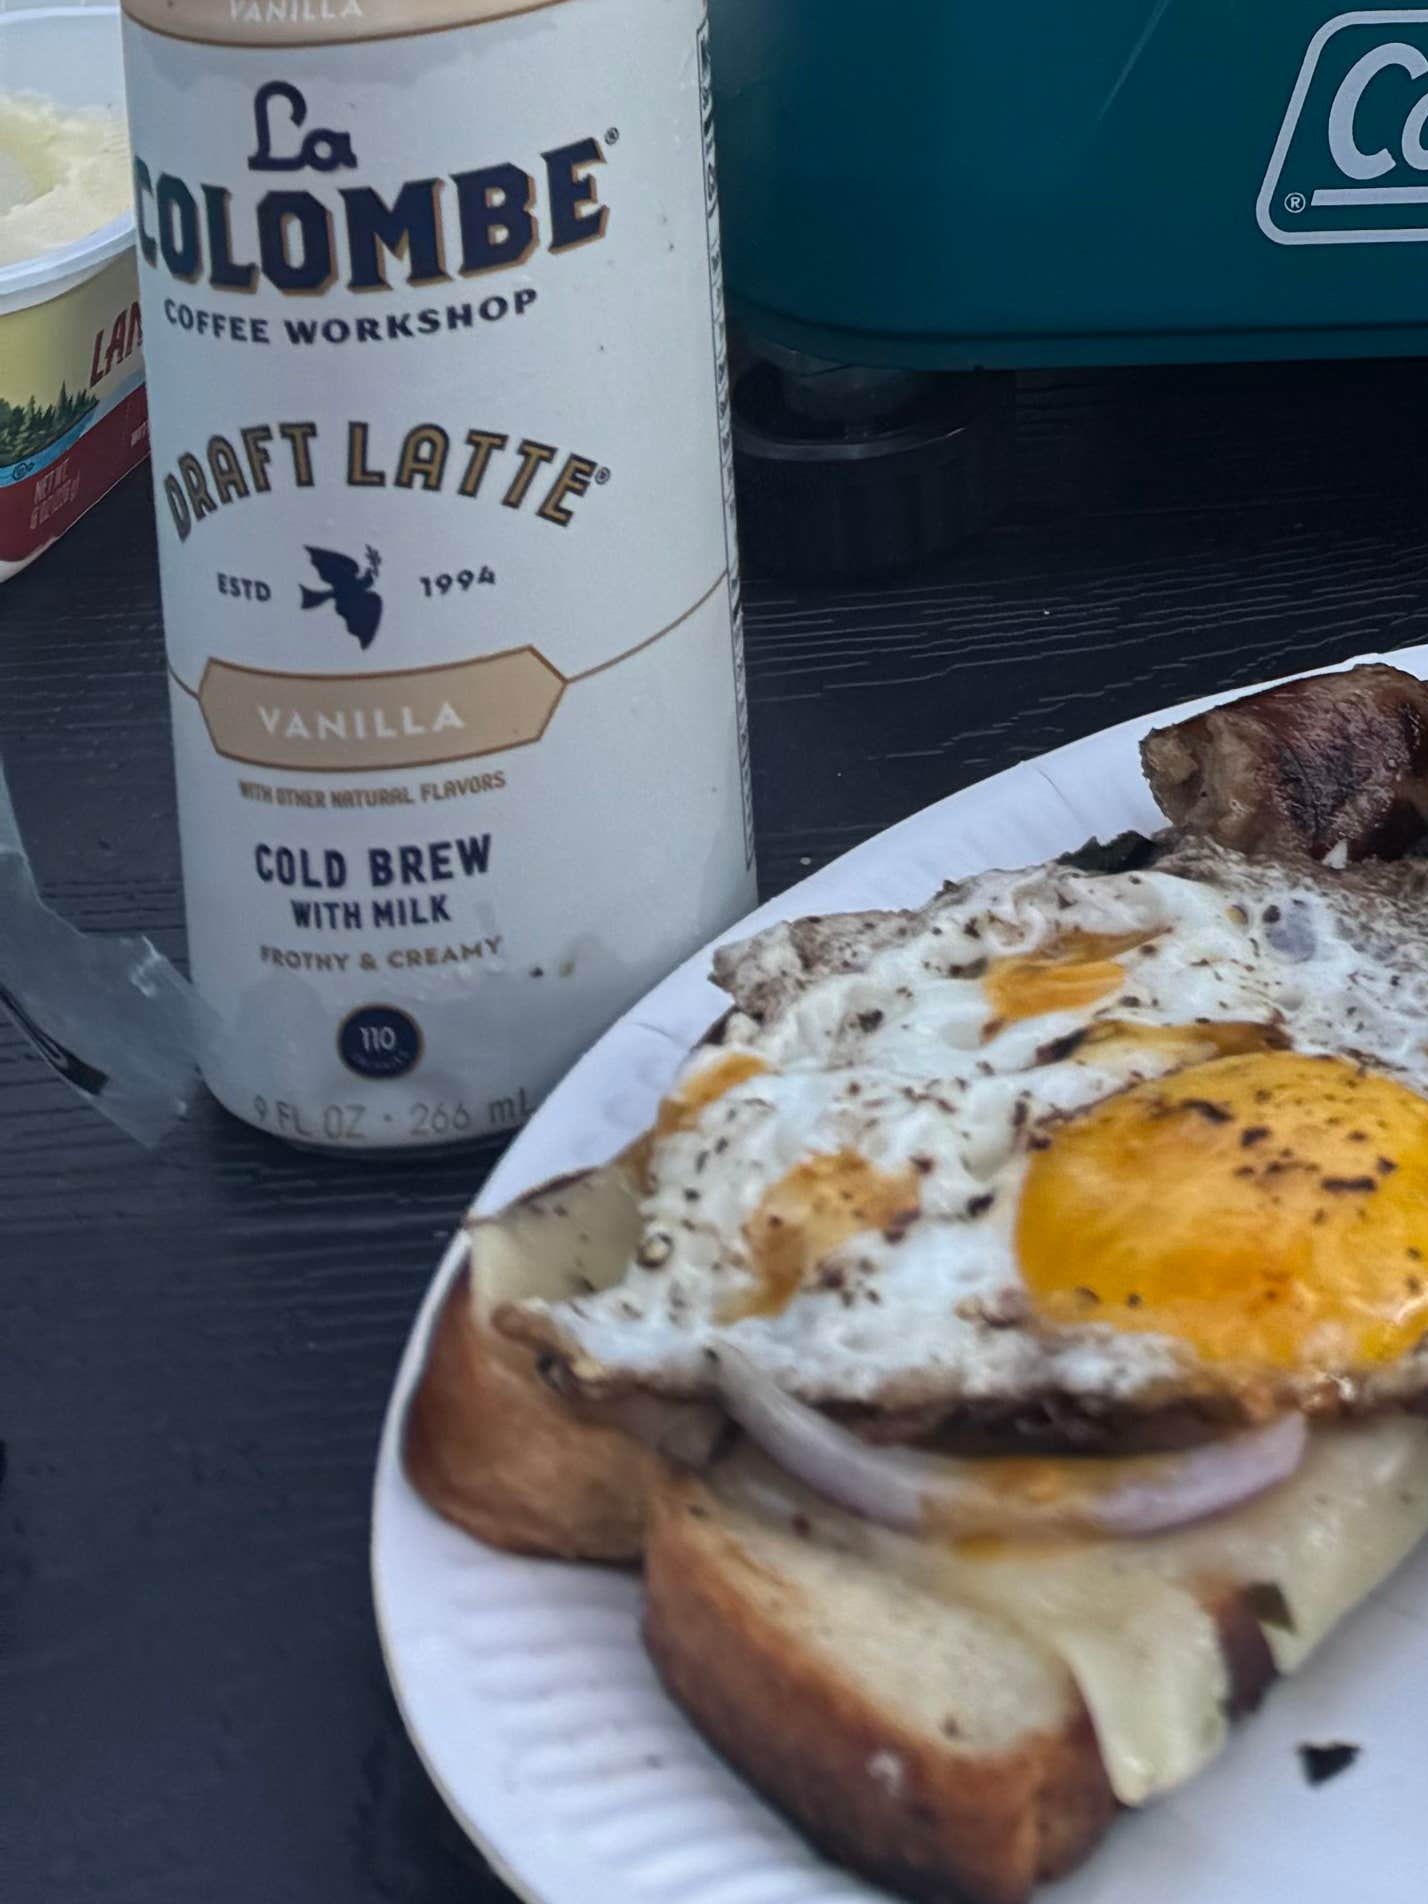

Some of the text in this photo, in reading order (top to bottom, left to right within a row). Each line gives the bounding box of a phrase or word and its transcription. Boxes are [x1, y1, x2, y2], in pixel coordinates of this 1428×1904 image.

[247, 80, 358, 173] La
[133, 136, 610, 298] COLOMBE
[164, 288, 538, 345] COFFEE WORKSHOP
[163, 421, 317, 543] DRAFT
[346, 420, 600, 528] LATTE
[215, 565, 497, 603] ESTD 1994
[257, 700, 466, 742] VANILLA
[239, 769, 508, 810] WITH OTHER NATURAL FLAVORS
[254, 832, 493, 889] COLD BREW
[290, 893, 453, 930] WITH MILK
[259, 934, 505, 972] FROTHY & CREAMY
[359, 1025, 398, 1053] 110
[277, 1102, 311, 1136] FL
[321, 1104, 367, 1140] OZ
[409, 1102, 472, 1137] 266
